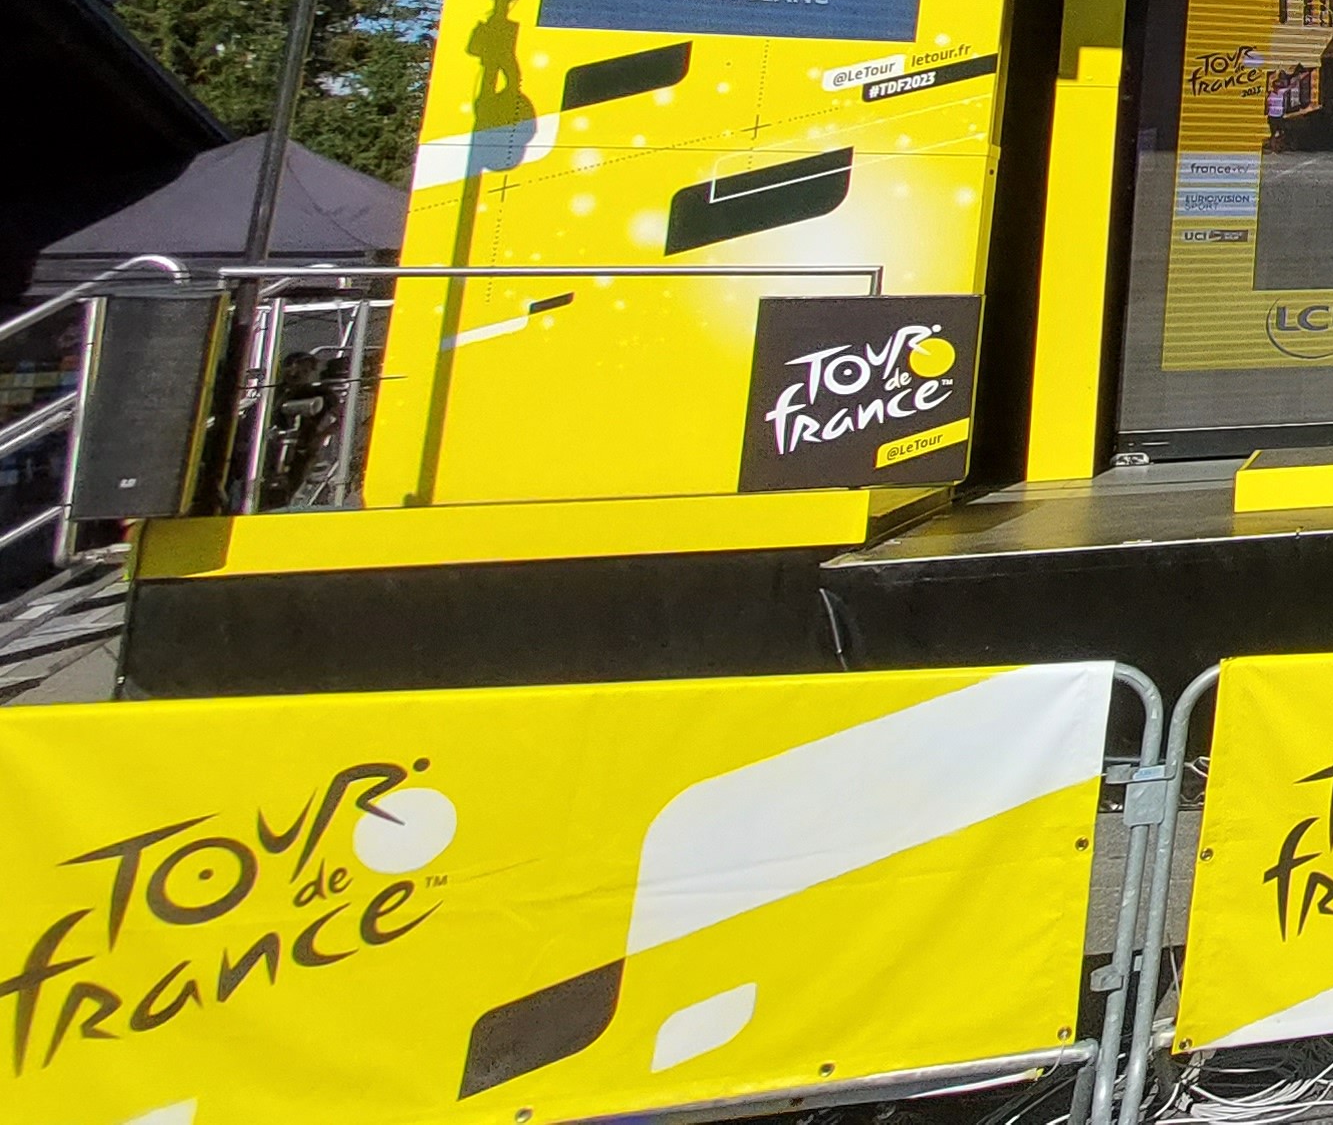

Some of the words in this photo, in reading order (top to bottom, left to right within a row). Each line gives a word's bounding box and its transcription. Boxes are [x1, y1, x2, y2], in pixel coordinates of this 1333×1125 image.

[911, 41, 971, 69] letour.fr
[1196, 46, 1257, 73] TOUR
[832, 57, 896, 89] @LeTour
[868, 71, 936, 100] #TDF2023
[1188, 67, 1262, 97] france
[1185, 231, 1207, 241] UCI
[784, 324, 942, 406] TOUR
[885, 368, 912, 393] de
[765, 376, 953, 455] france
[885, 432, 943, 463] @LeTour
[56, 756, 431, 953] TOUR
[293, 859, 352, 908] de
[0, 879, 444, 1075] france
